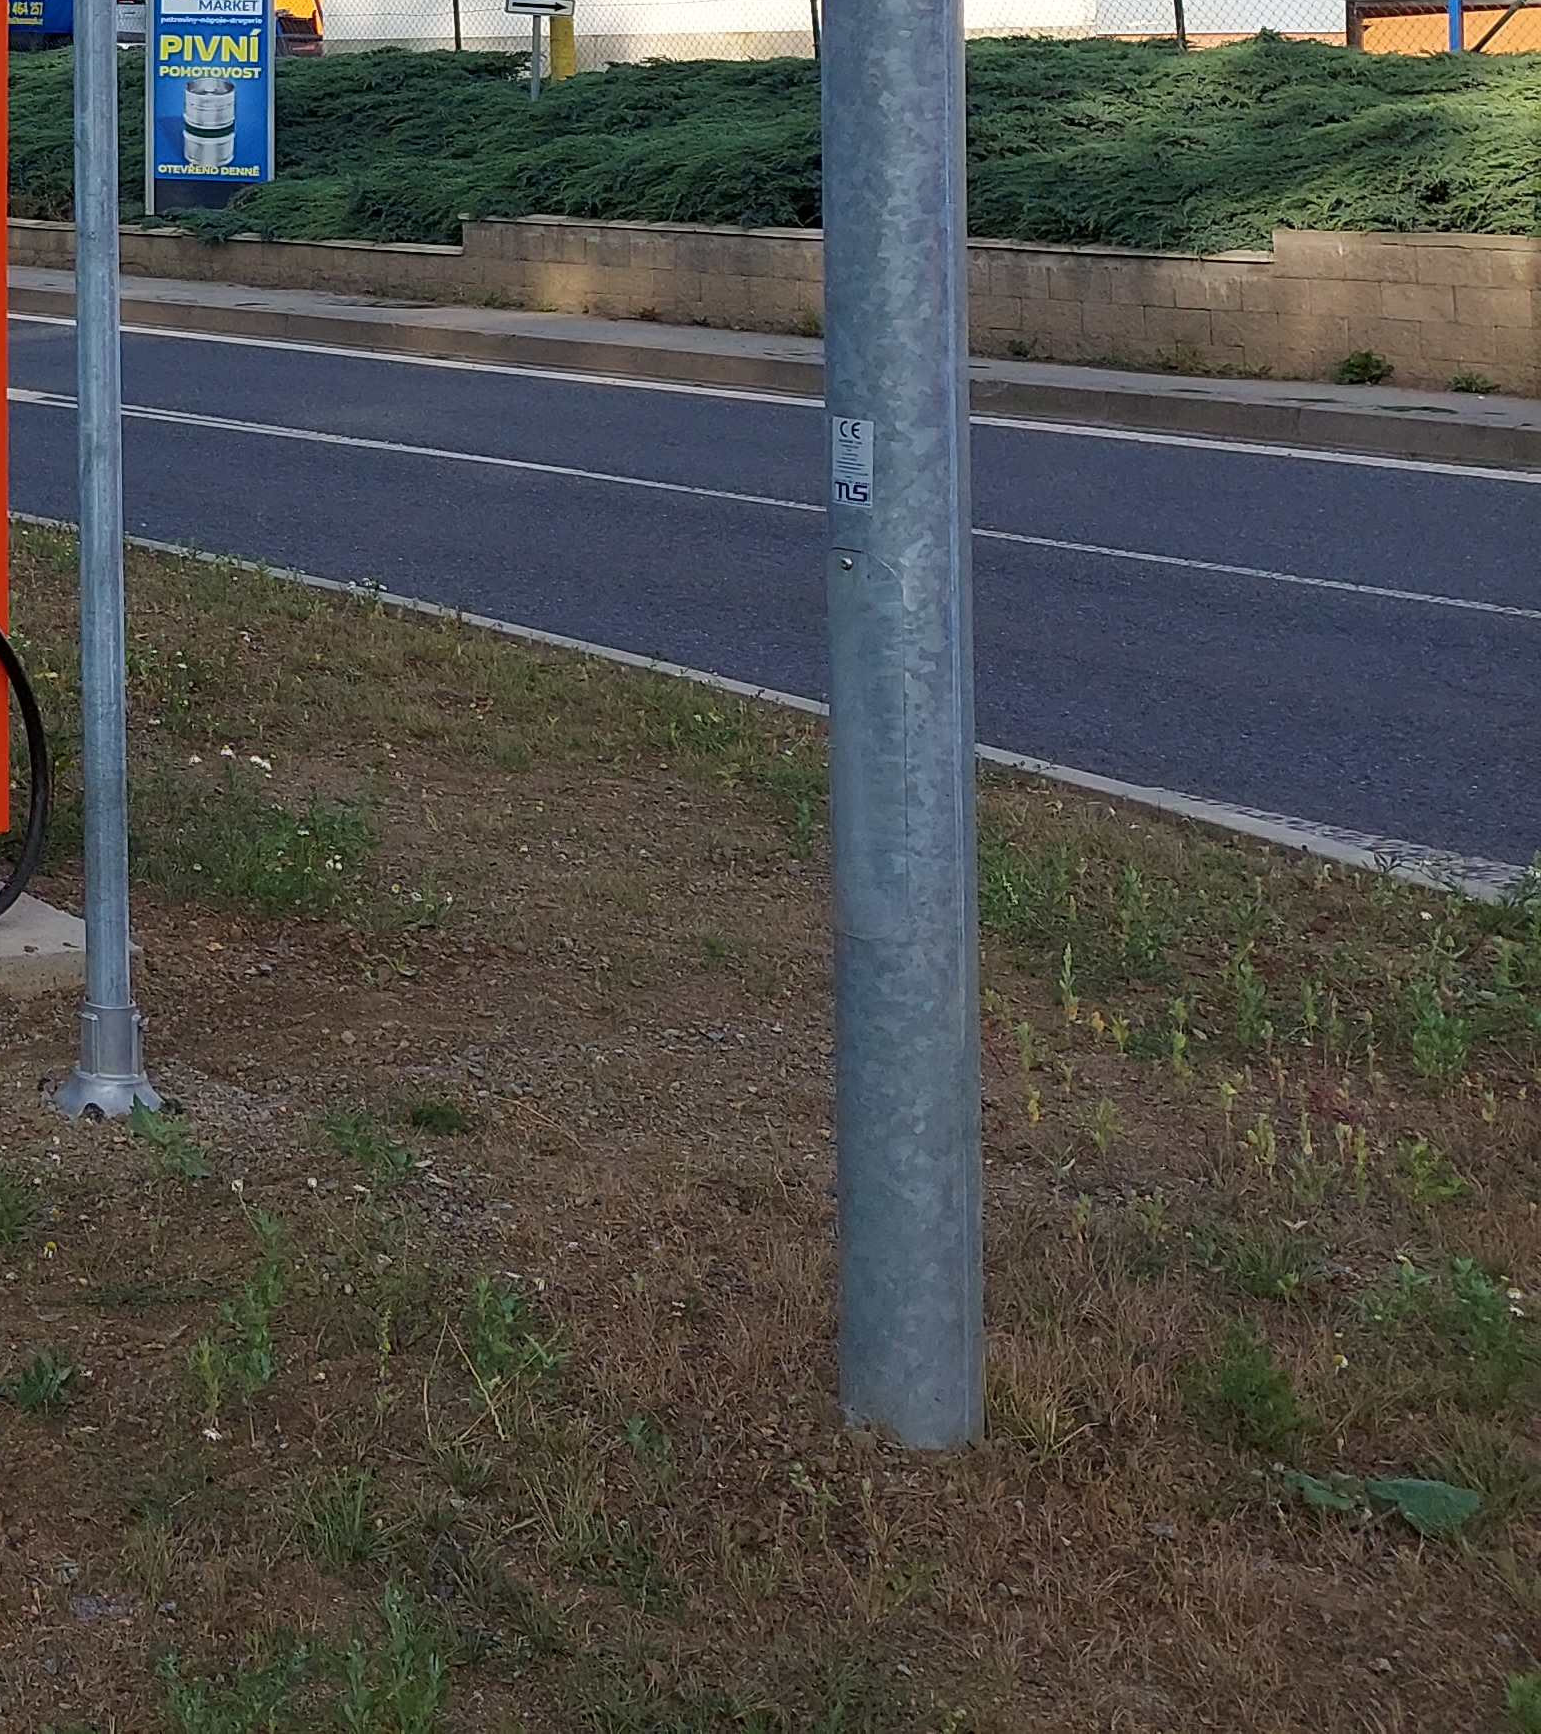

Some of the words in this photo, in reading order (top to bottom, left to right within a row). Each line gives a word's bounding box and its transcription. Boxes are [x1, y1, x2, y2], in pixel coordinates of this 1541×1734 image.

[199, 0, 259, 12] MARKET
[159, 28, 262, 63] PIVNÍ
[159, 65, 262, 79] POHOTOVOST
[157, 162, 219, 175] OTEVŘENO
